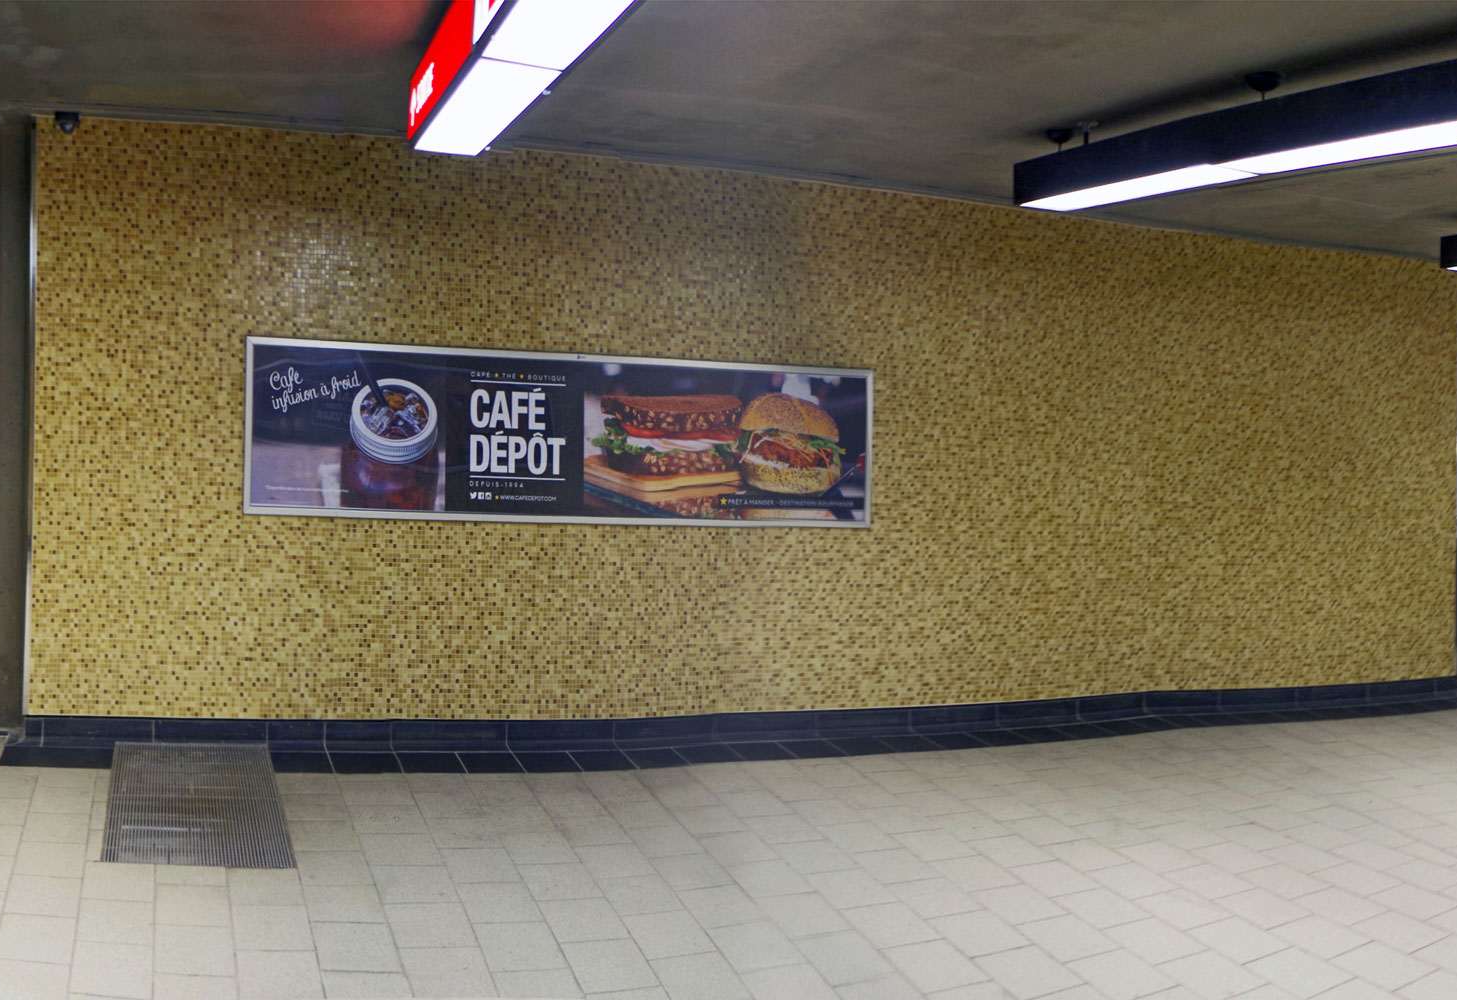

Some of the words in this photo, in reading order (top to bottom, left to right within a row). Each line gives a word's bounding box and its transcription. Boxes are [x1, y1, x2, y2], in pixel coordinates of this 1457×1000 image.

[269, 366, 304, 394] Café
[271, 388, 319, 413] infusion
[330, 370, 362, 400] froid
[502, 372, 516, 380] THÉ
[527, 374, 567, 382] BOUTIQUE
[470, 387, 546, 431] CAFÉ
[469, 430, 566, 475] DÉPÔT
